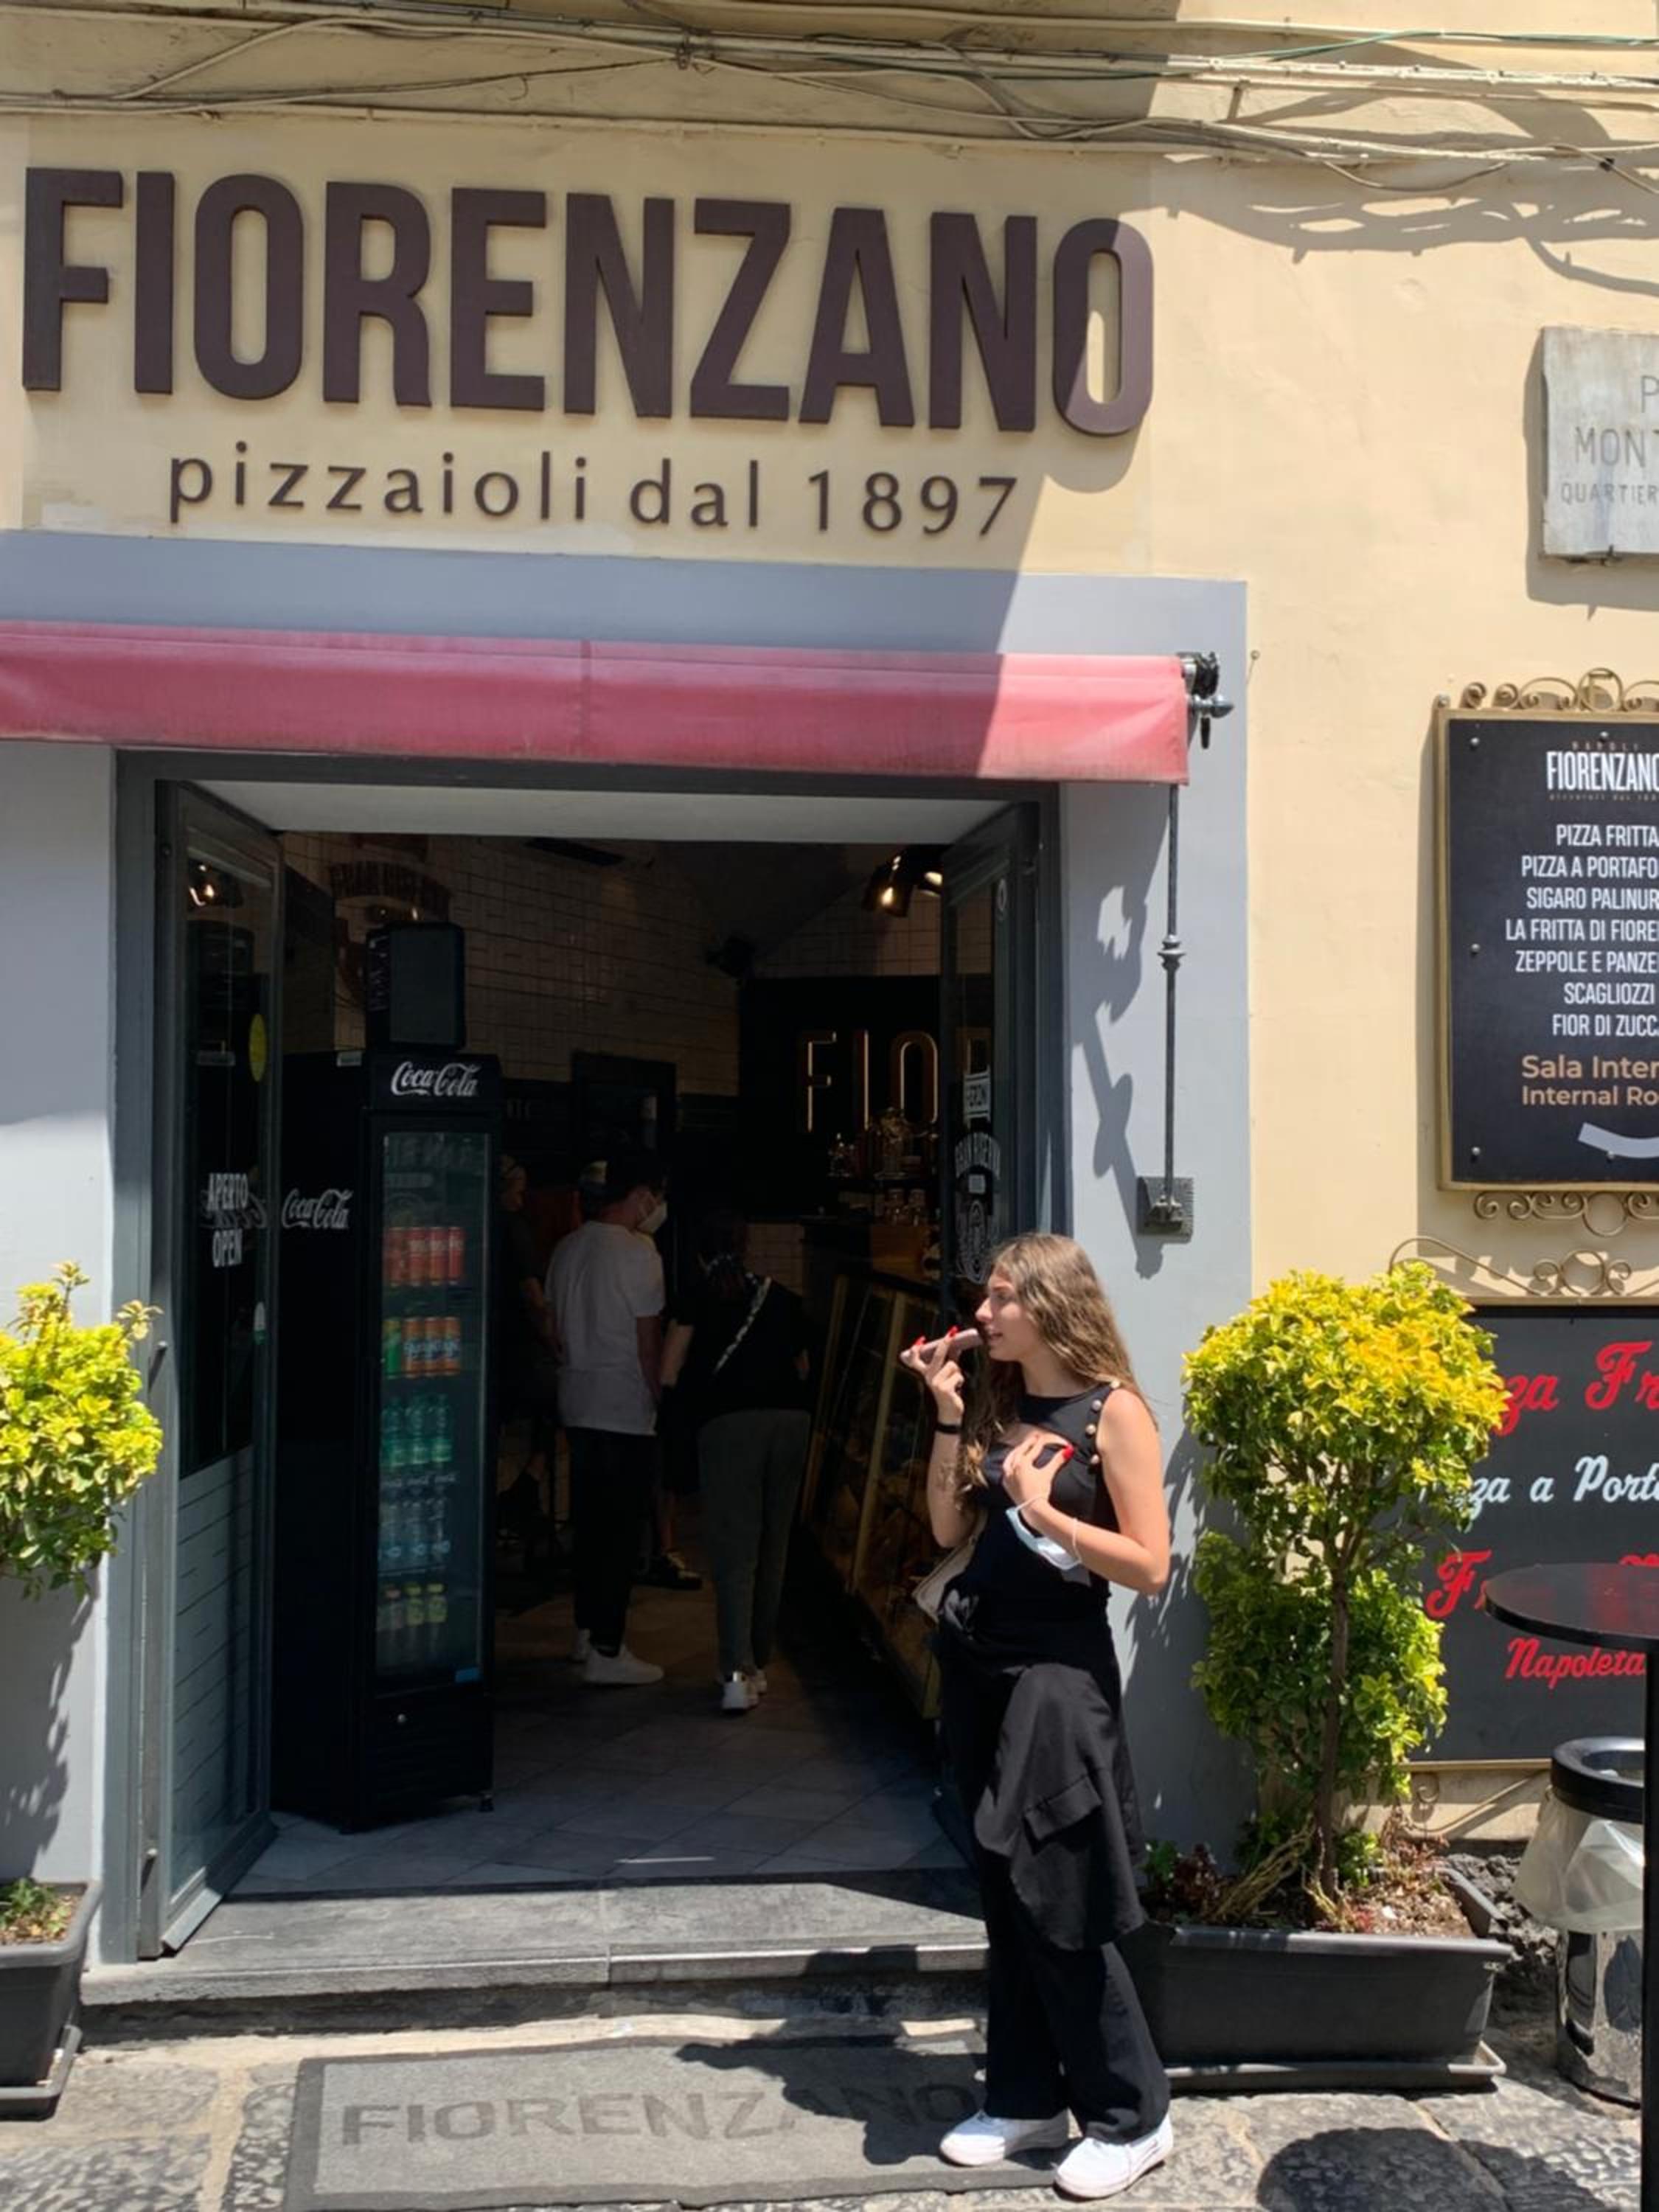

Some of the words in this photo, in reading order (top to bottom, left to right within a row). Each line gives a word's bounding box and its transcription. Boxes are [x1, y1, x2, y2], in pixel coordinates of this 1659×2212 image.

[22, 167, 1153, 437] FIORENZANO
[1574, 425, 1659, 468] MON
[170, 440, 587, 523] pizzaioli
[630, 458, 759, 528] dal
[807, 470, 1018, 536] 1897
[1562, 484, 1659, 505] QUARTIER
[1557, 824, 1601, 846] PIZZA
[1606, 824, 1659, 847] FRITTA
[1521, 855, 1568, 877] PIZZA
[1571, 856, 1583, 877] A
[1587, 857, 1658, 879] PORTAFO
[1526, 887, 1587, 909] SIGARO
[1592, 888, 1659, 910] PALINUR
[1506, 919, 1526, 941] LA
[1530, 919, 1585, 941] FRITTA
[1590, 920, 1605, 942] DI
[1515, 950, 1587, 973] ZEPPOLE
[1592, 951, 1601, 973] E
[1564, 982, 1655, 1005] SCAGLIOZZI
[1552, 1014, 1590, 1036] FIOR
[1595, 1015, 1611, 1036] DI
[1615, 1015, 1659, 1037] ZUCC
[1522, 1054, 1582, 1078] Sala
[391, 1061, 481, 1097] Coca-Cola
[1522, 1085, 1618, 1105] Internal
[206, 1172, 249, 1211] APERTO
[282, 1189, 353, 1230] Coca-Cola
[212, 1228, 243, 1268] OPEN
[1529, 1477, 1554, 1503] a
